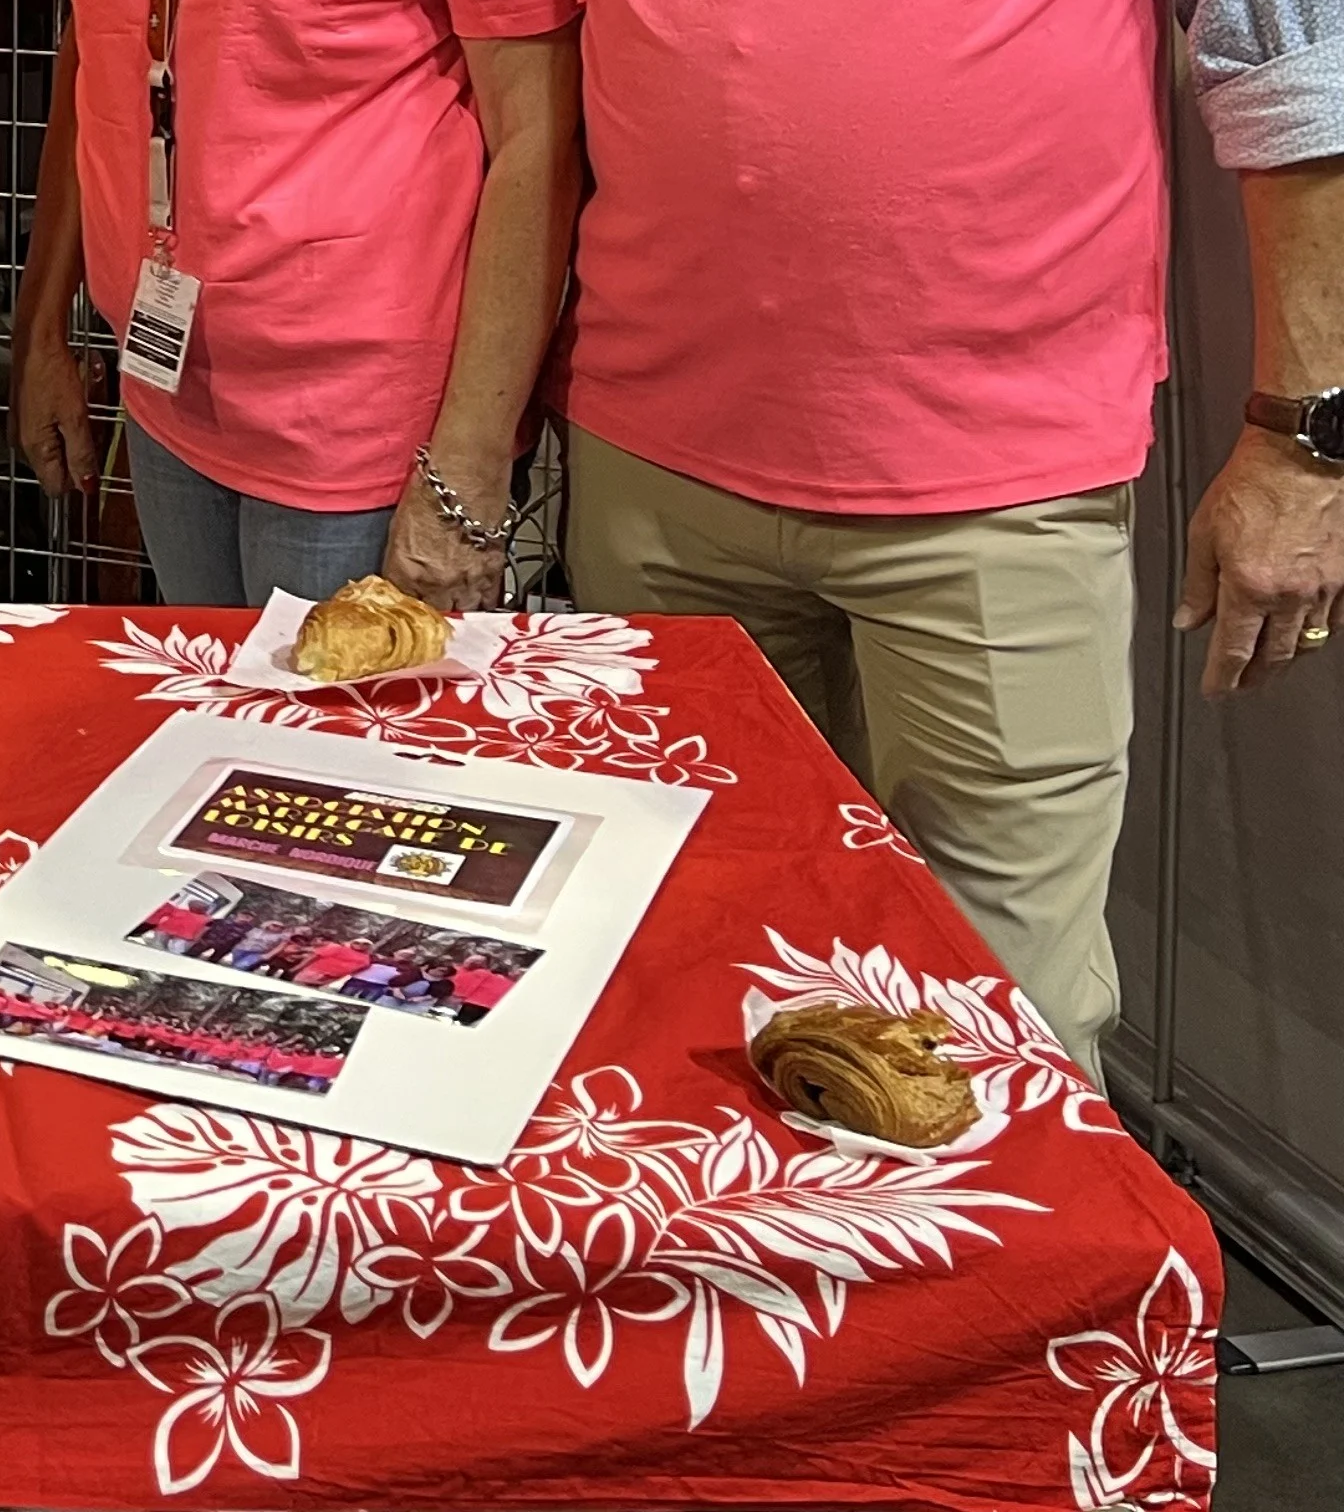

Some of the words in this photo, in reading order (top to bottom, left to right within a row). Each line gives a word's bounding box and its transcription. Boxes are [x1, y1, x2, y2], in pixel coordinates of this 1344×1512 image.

[223, 784, 487, 836] ASSOCIATION
[203, 809, 354, 847] LOISIRS
[207, 832, 282, 854] MARCHE
[458, 837, 513, 856] DE
